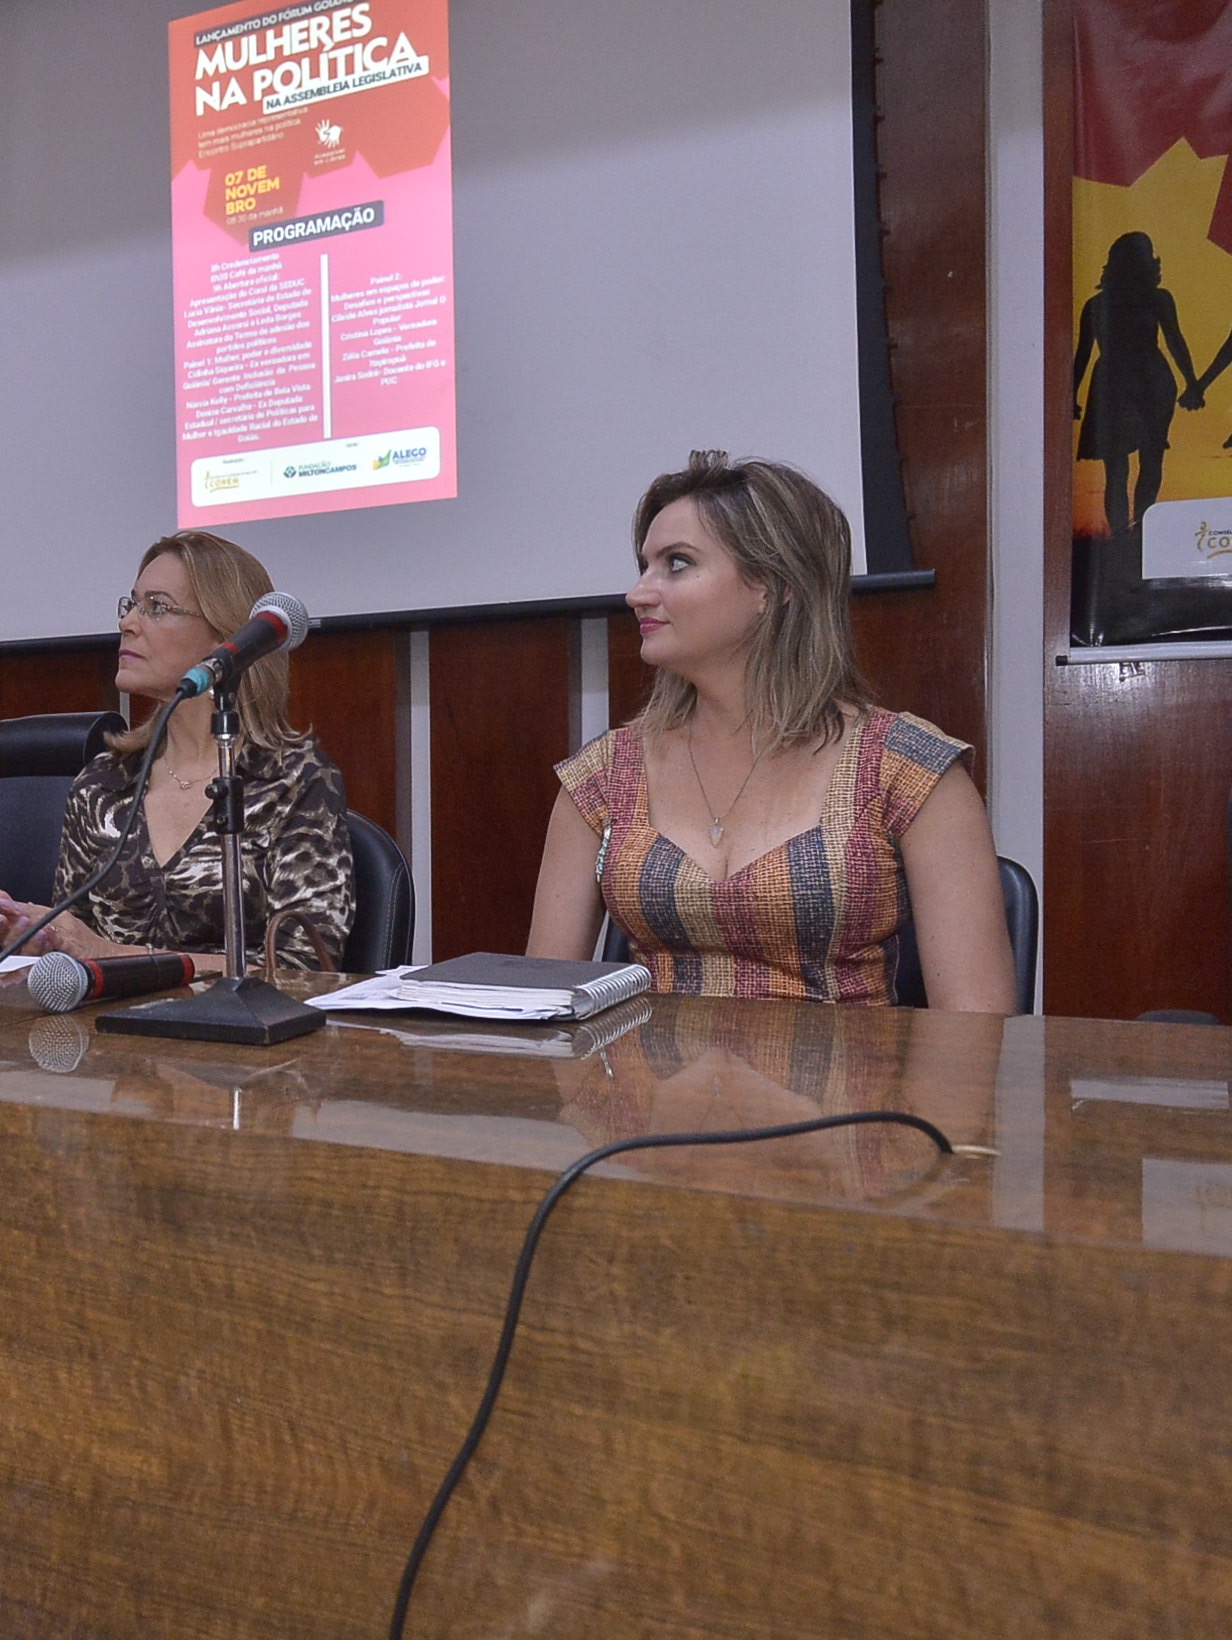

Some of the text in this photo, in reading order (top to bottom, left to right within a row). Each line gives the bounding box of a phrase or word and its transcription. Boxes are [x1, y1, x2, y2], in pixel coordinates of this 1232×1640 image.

[195, 4, 313, 45] LANÇAMENTO DO FÓRUM
[195, 3, 372, 80] MULHERES
[195, 31, 418, 117] NA POLÍTICA
[266, 62, 422, 110] NA ASSEMBLEIA LEGISLATIVA
[225, 165, 267, 186] 07 DE
[225, 177, 280, 201] NOVEM
[225, 198, 256, 215] BRO
[253, 206, 375, 246] PROGRAMAÇÃO
[392, 447, 427, 459] ALEGO
